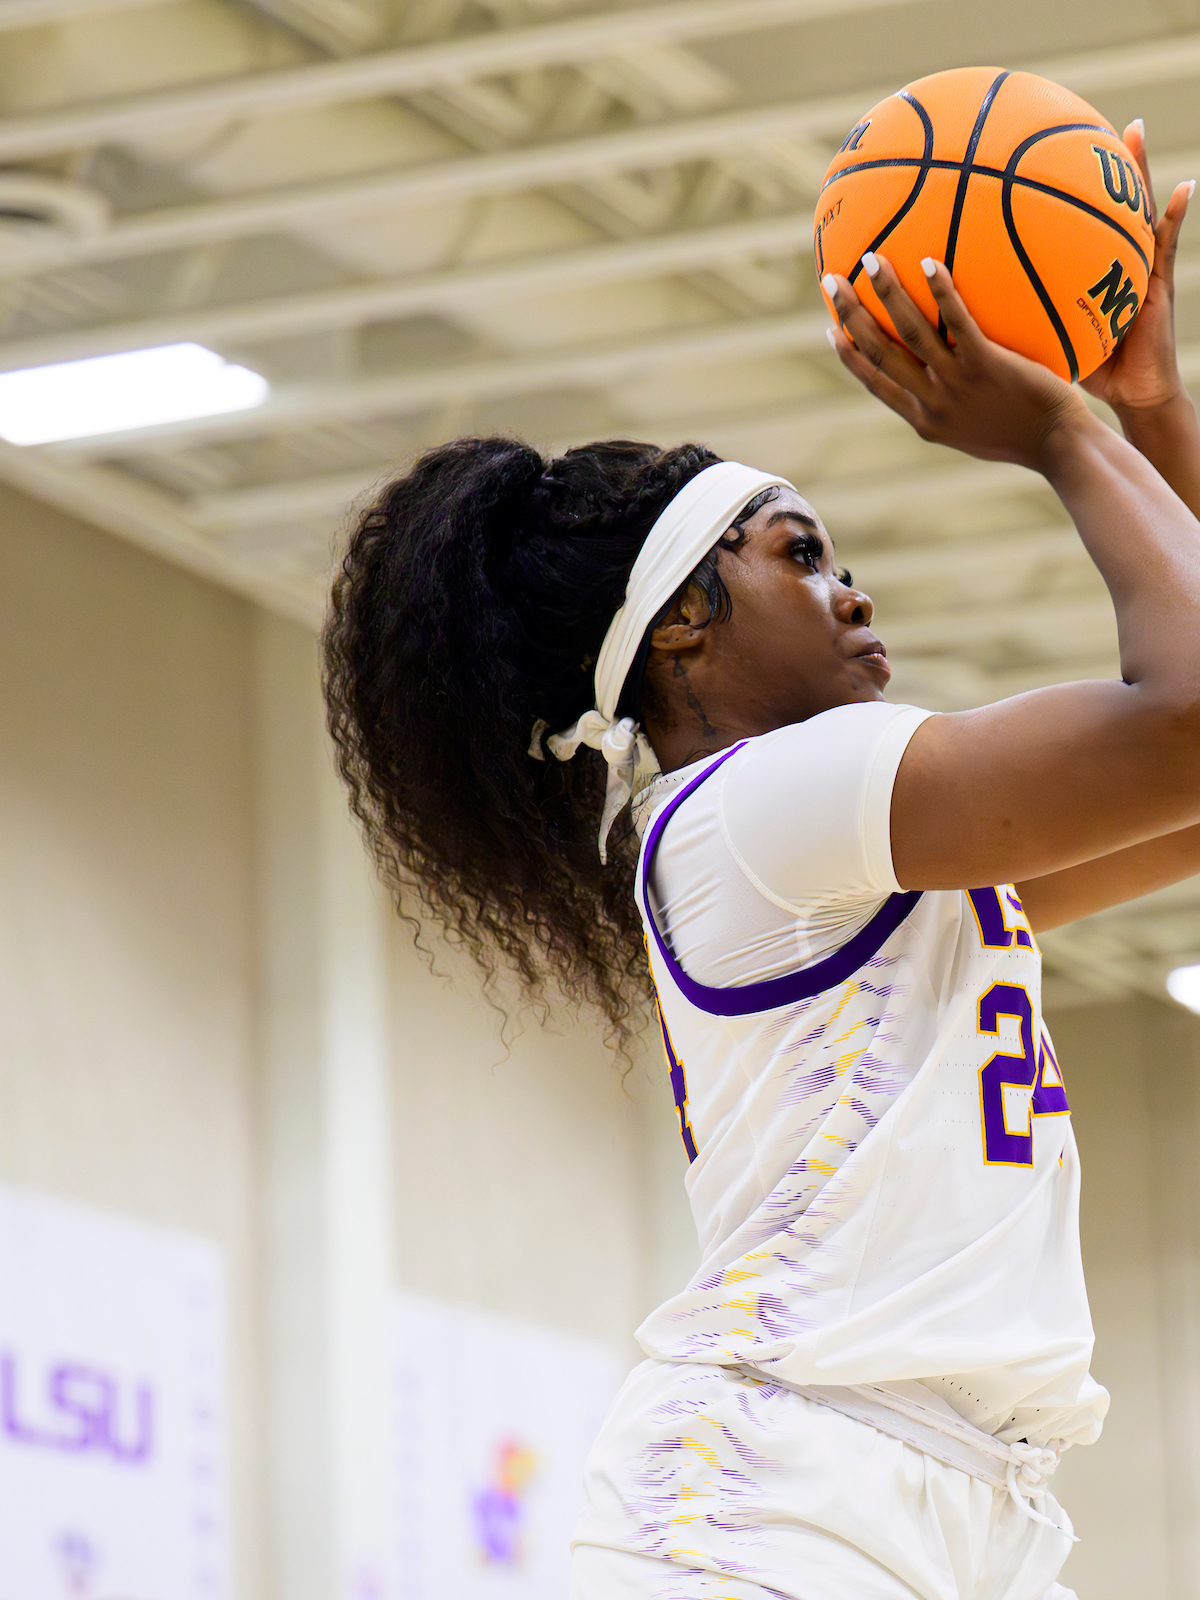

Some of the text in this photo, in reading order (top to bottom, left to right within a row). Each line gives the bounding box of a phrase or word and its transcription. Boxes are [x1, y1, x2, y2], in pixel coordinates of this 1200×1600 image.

[822, 198, 844, 232] NXT
[1076, 297, 1105, 342] OFFICIAL
[0, 1346, 154, 1468] LSU
